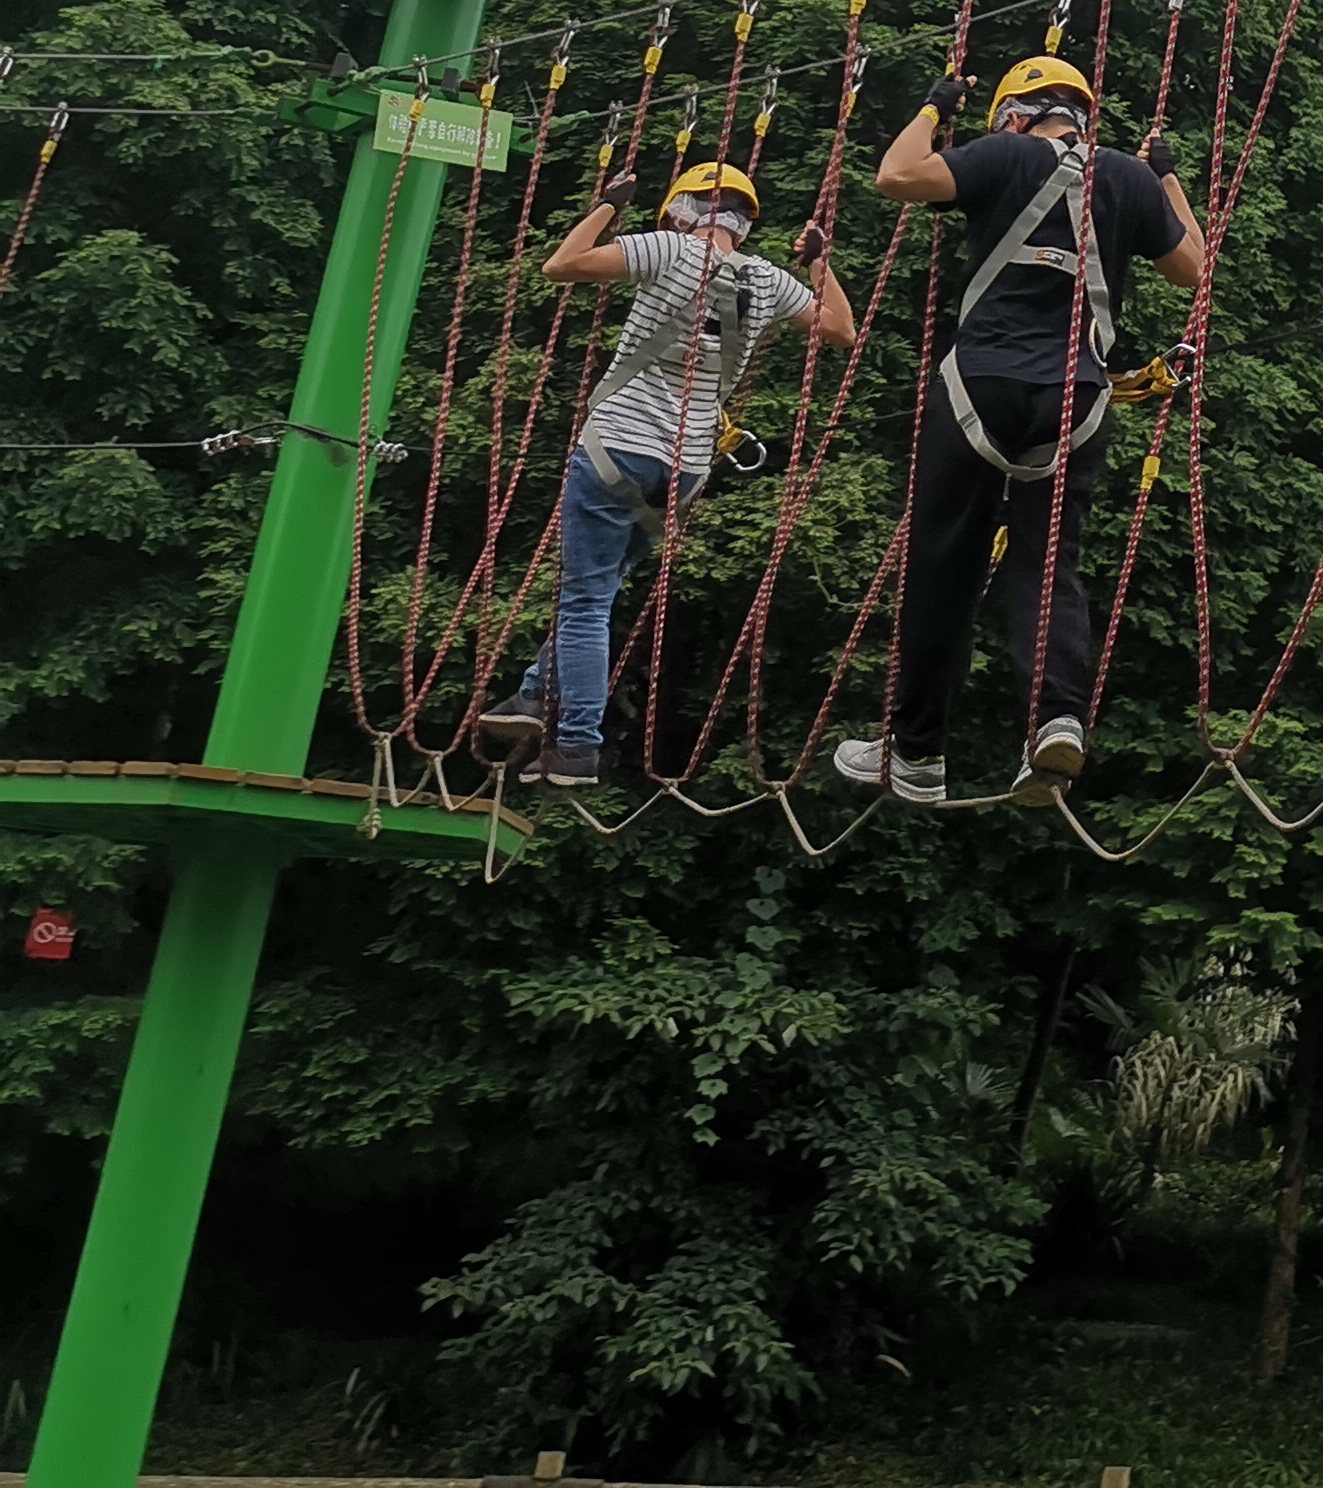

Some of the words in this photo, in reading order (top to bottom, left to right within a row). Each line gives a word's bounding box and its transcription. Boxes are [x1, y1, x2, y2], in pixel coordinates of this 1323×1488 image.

[388, 113, 502, 150] 体验严禁自行解除备！
